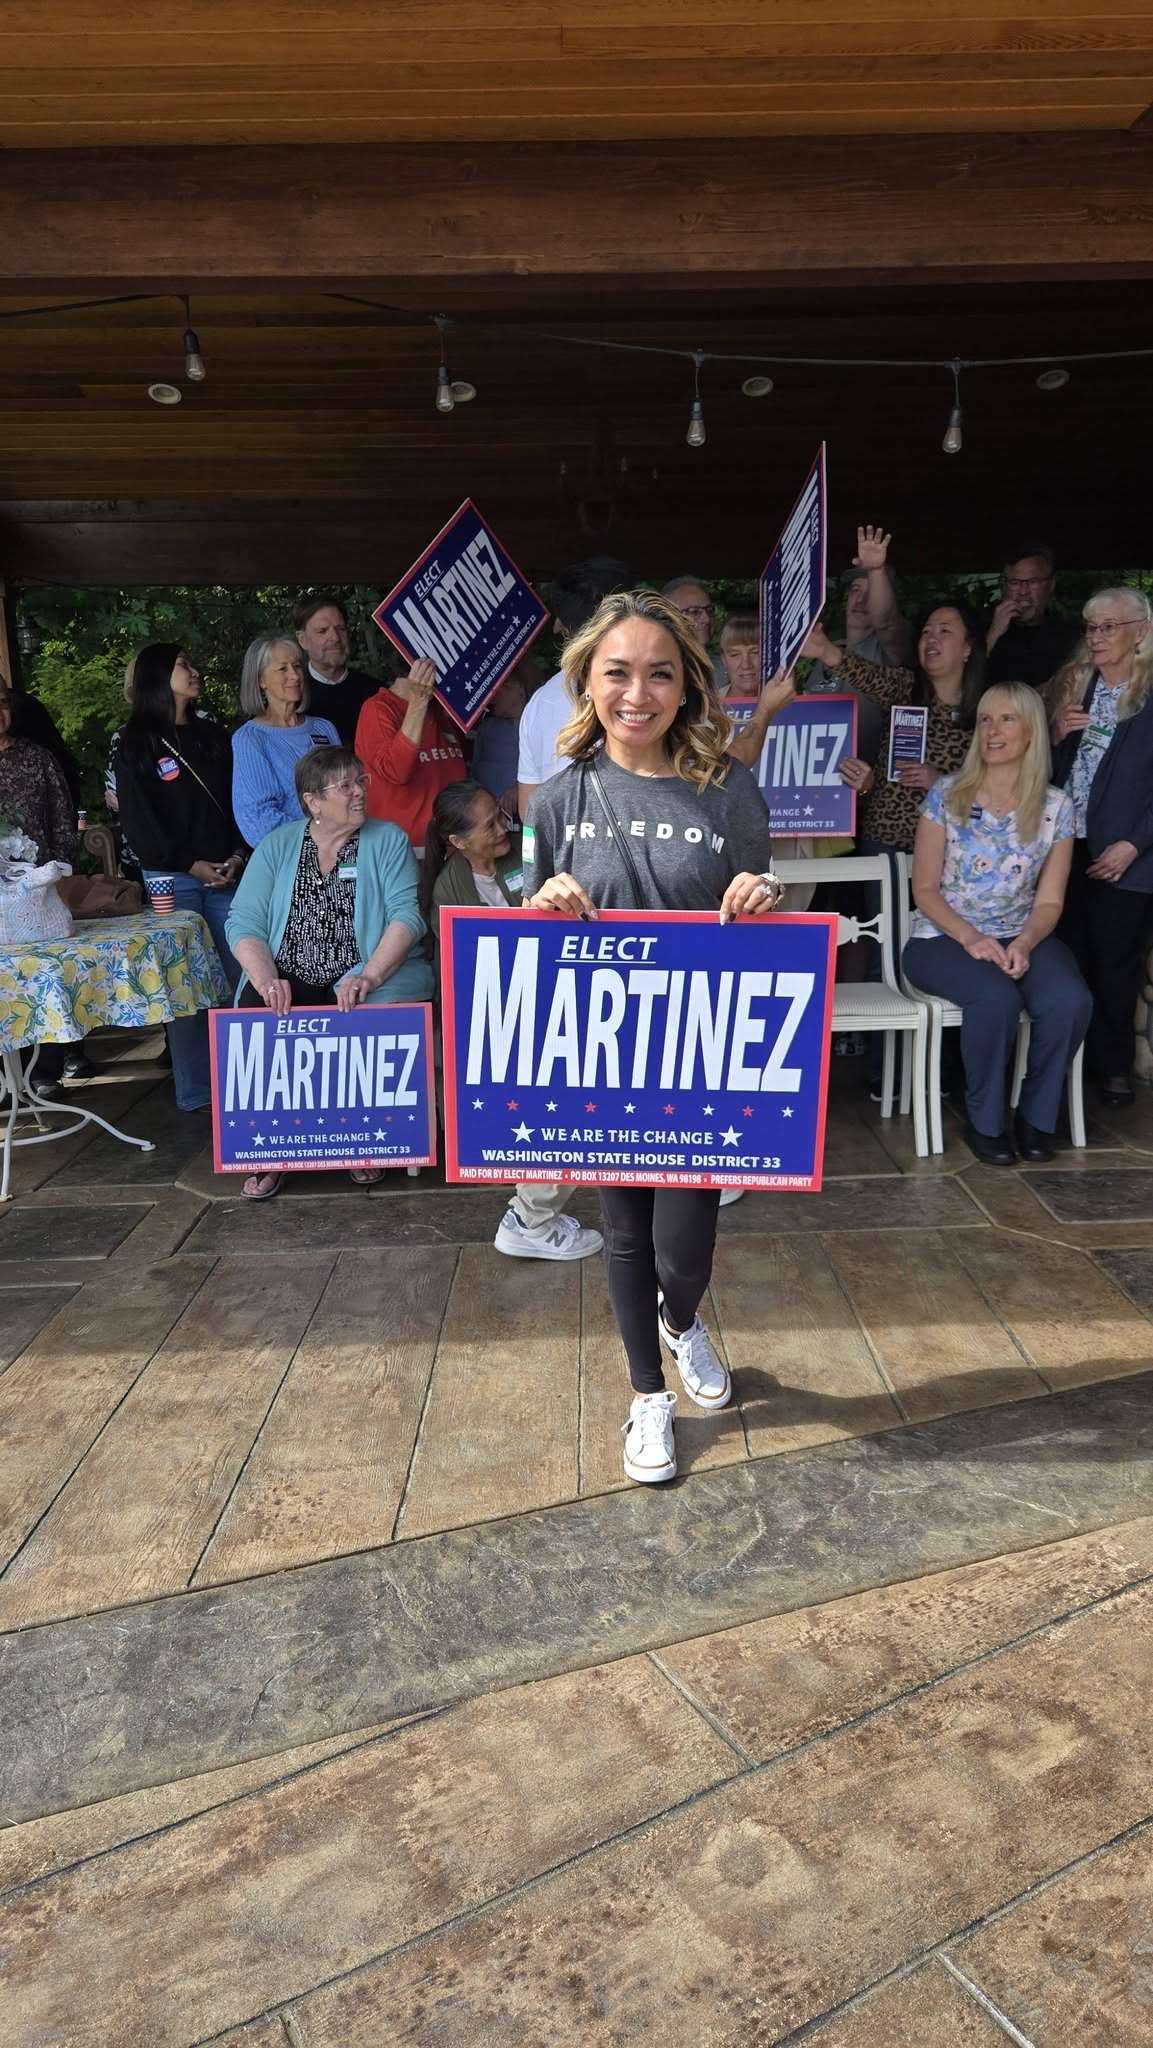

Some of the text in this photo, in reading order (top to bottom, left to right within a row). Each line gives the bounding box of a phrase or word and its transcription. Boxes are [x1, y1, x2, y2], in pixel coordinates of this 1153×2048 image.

[413, 560, 442, 598] ELECT
[392, 528, 516, 684] MARTINEZ
[726, 710, 752, 720] ELE
[419, 747, 463, 762] REEDO
[769, 808, 800, 816] HANGE
[824, 820, 835, 828] 33
[565, 820, 725, 854] FREDOM
[560, 936, 657, 961] ELECT
[466, 935, 816, 1092] MARTINEZ
[276, 1018, 331, 1034] ELECT
[225, 1021, 420, 1112] MARTINEZ
[269, 1133, 370, 1144] WE ARE THE CHANGE
[540, 1128, 714, 1145] WE ARE THE CHANGE
[234, 1145, 411, 1159] WASHINGTON STATE HOUSE DISTRICT 33
[482, 1149, 781, 1169] WASHINGTON STATE HOUSE DISTRICT 33
[459, 1168, 813, 1187] PAID FOR BY ELECT MARTINEZ PO BOX 13207 DES MOINES, WA 98198 PREFERS REPUBLICAN PARTY
[545, 1228, 567, 1248] N
